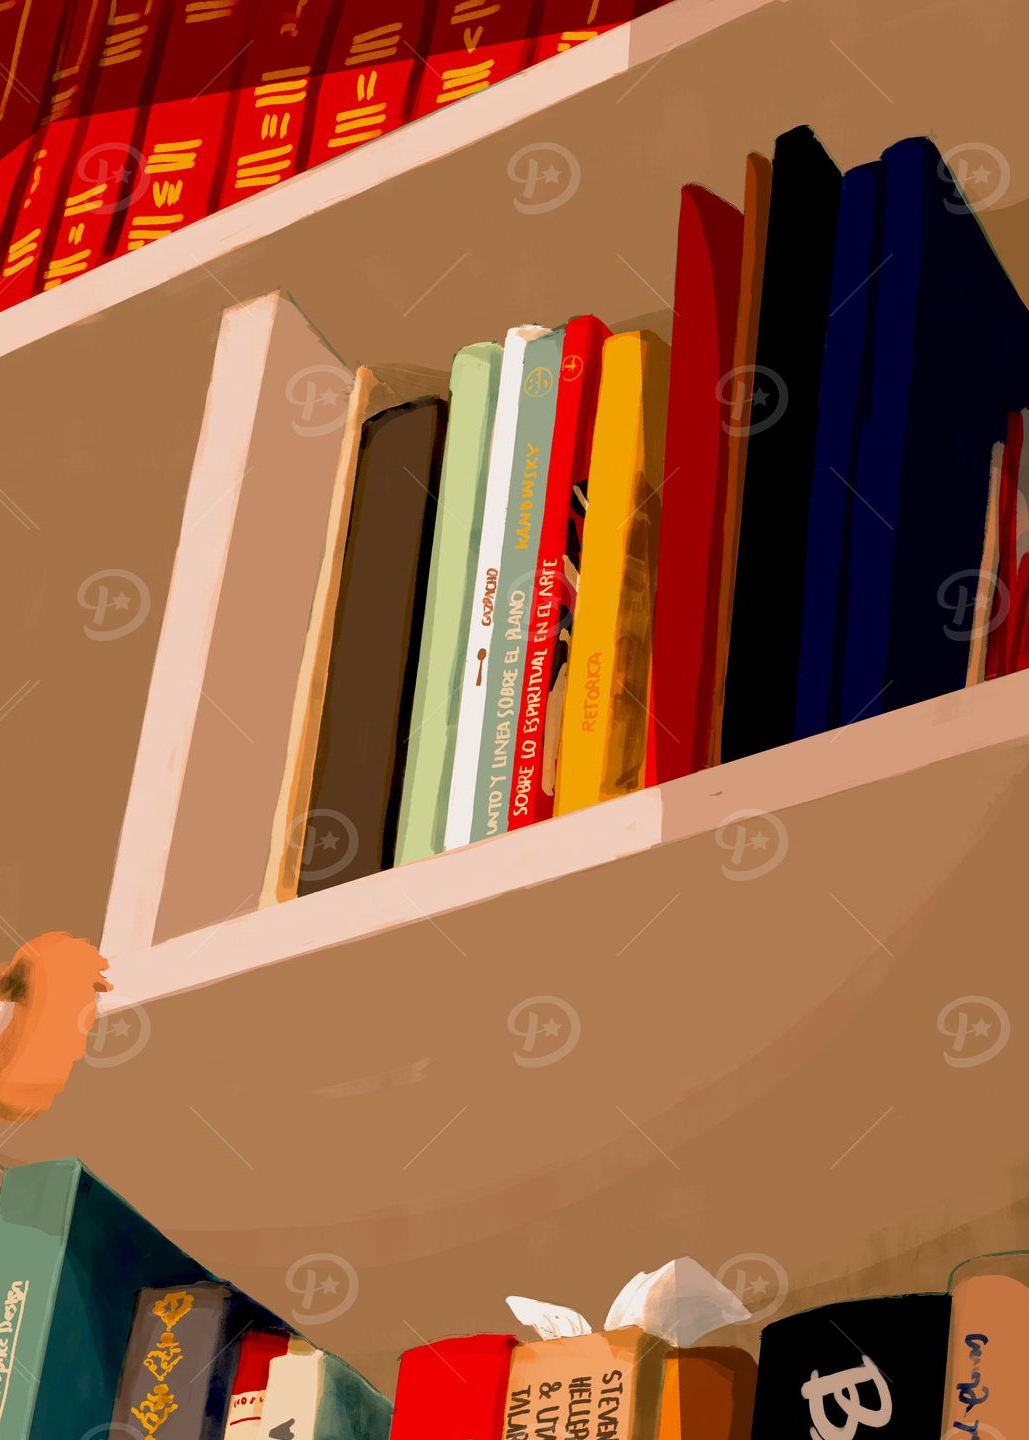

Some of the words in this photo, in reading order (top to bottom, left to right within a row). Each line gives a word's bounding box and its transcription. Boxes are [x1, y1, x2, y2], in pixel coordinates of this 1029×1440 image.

[481, 567, 499, 627] GAZPACHO
[538, 558, 558, 598] ARTE
[504, 589, 526, 640] PLANO
[537, 600, 553, 618] EL
[533, 620, 549, 643] EN
[503, 645, 521, 664] EL
[496, 668, 519, 719] SOBRE
[522, 648, 549, 734] ESPIRITUAL
[491, 720, 511, 769] LINEA
[520, 739, 538, 760] LO
[489, 774, 508, 789] Y
[513, 765, 535, 817] SOBRE
[538, 1380, 563, 1401] &
